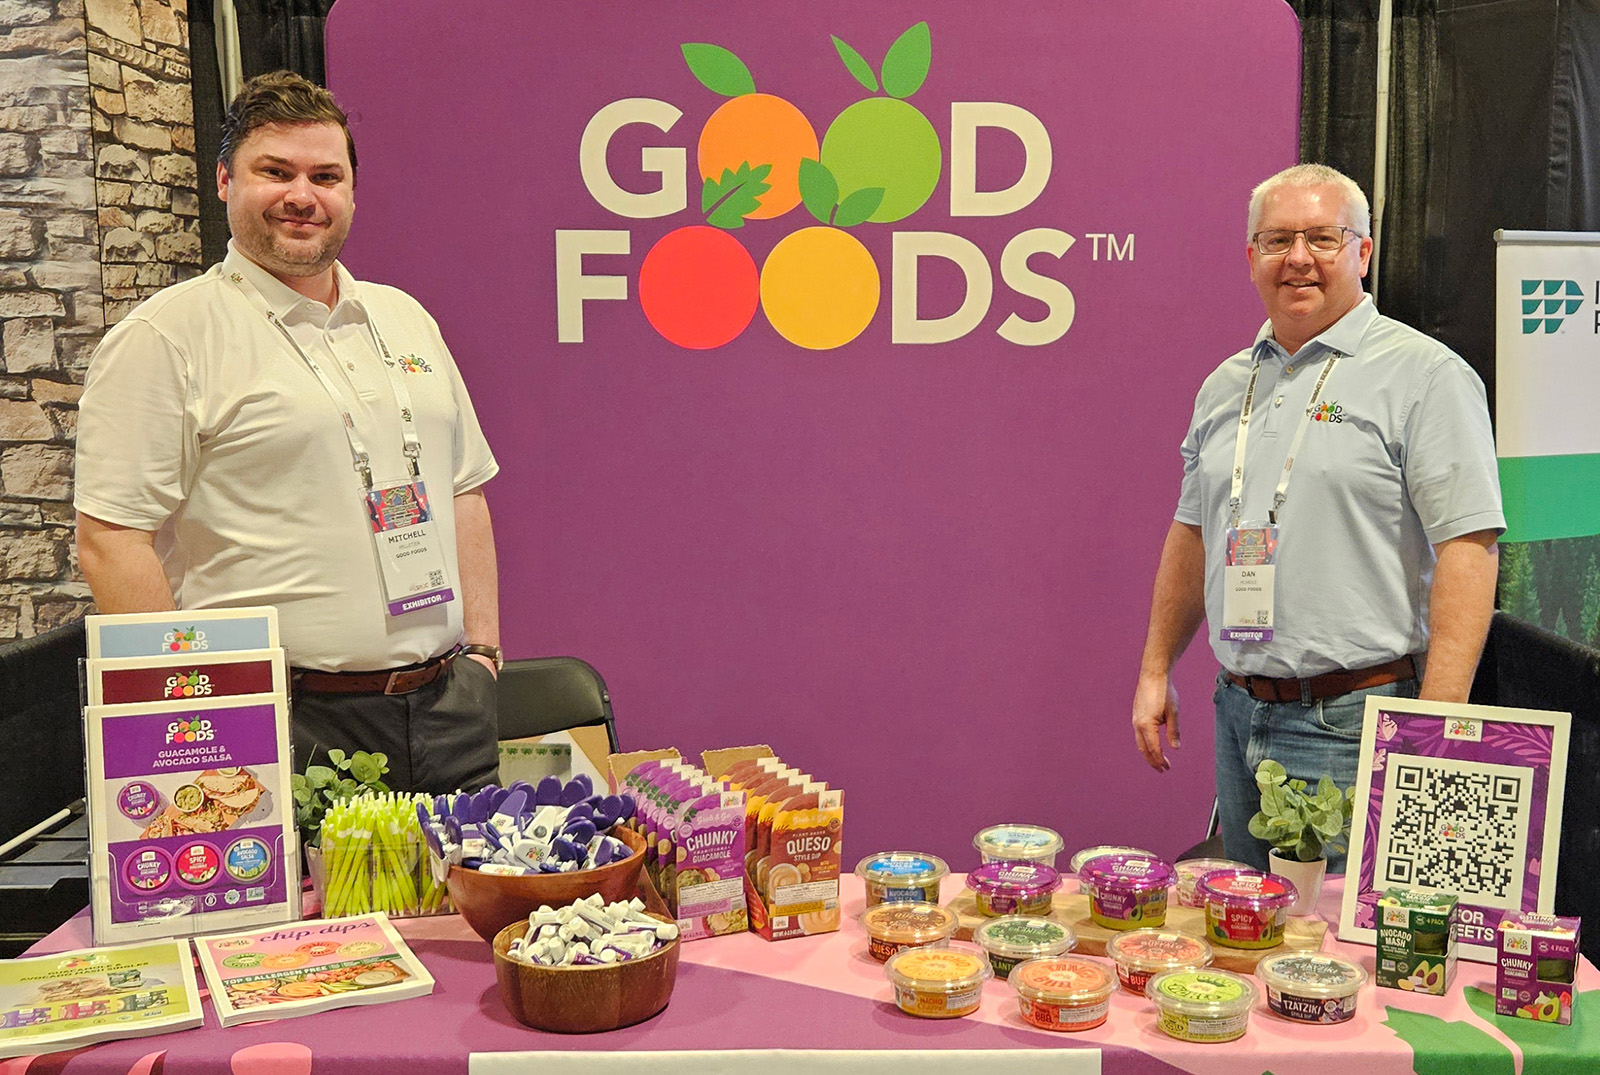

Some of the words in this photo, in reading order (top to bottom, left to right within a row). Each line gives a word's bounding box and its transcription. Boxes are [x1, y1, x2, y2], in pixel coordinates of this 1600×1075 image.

[579, 93, 1053, 221] GOOD
[555, 226, 1076, 351] FOODS
[388, 529, 427, 544] MITCHELL
[1241, 570, 1256, 578] DAN
[164, 631, 206, 642] GOOD
[162, 640, 209, 652] FOODS
[166, 675, 210, 687] GOOD
[164, 684, 213, 698] FOODS
[167, 720, 212, 734] GOOD
[1449, 728, 1476, 737] FOODS
[1451, 722, 1476, 731] GOOD
[165, 729, 215, 744] FOODS
[158, 746, 218, 758] GUACAMOLE
[152, 757, 200, 768] AVOCADO
[201, 754, 232, 763] SALSA
[1438, 830, 1466, 839] FOODS
[1440, 824, 1465, 833] GOOD
[686, 830, 738, 851] CHUNKY
[786, 836, 832, 855] QUESO
[189, 856, 207, 864] SPICY
[692, 850, 732, 863] GUACAMOLE
[794, 854, 811, 862] STYLE
[811, 852, 821, 860] DIP
[998, 871, 1039, 880] CHUNKY
[1112, 865, 1155, 874] CHUNKY
[1231, 881, 1264, 889] SPICY
[888, 890, 918, 898] AVOCADO
[1100, 892, 1128, 904] CHUNKY
[895, 912, 930, 921] QUESO
[1230, 913, 1254, 924] SPICY
[260, 929, 315, 943] chip
[319, 922, 377, 936] dips
[1380, 929, 1412, 942] AVOCADO
[1457, 923, 1494, 942] EETS
[1140, 939, 1184, 950] BUFFALO
[1385, 937, 1406, 948] MASH
[47, 965, 112, 975] GUACAMOLE
[1501, 957, 1534, 971] CHUNKY
[20, 972, 73, 982] AVOCADO
[224, 978, 243, 986] TOP
[254, 969, 302, 981] ALLERGEN
[304, 965, 328, 974] FREE
[1130, 975, 1150, 985] BUFF
[1283, 1000, 1322, 1015] TZATZIKI
[1034, 1011, 1053, 1024] BBQ
